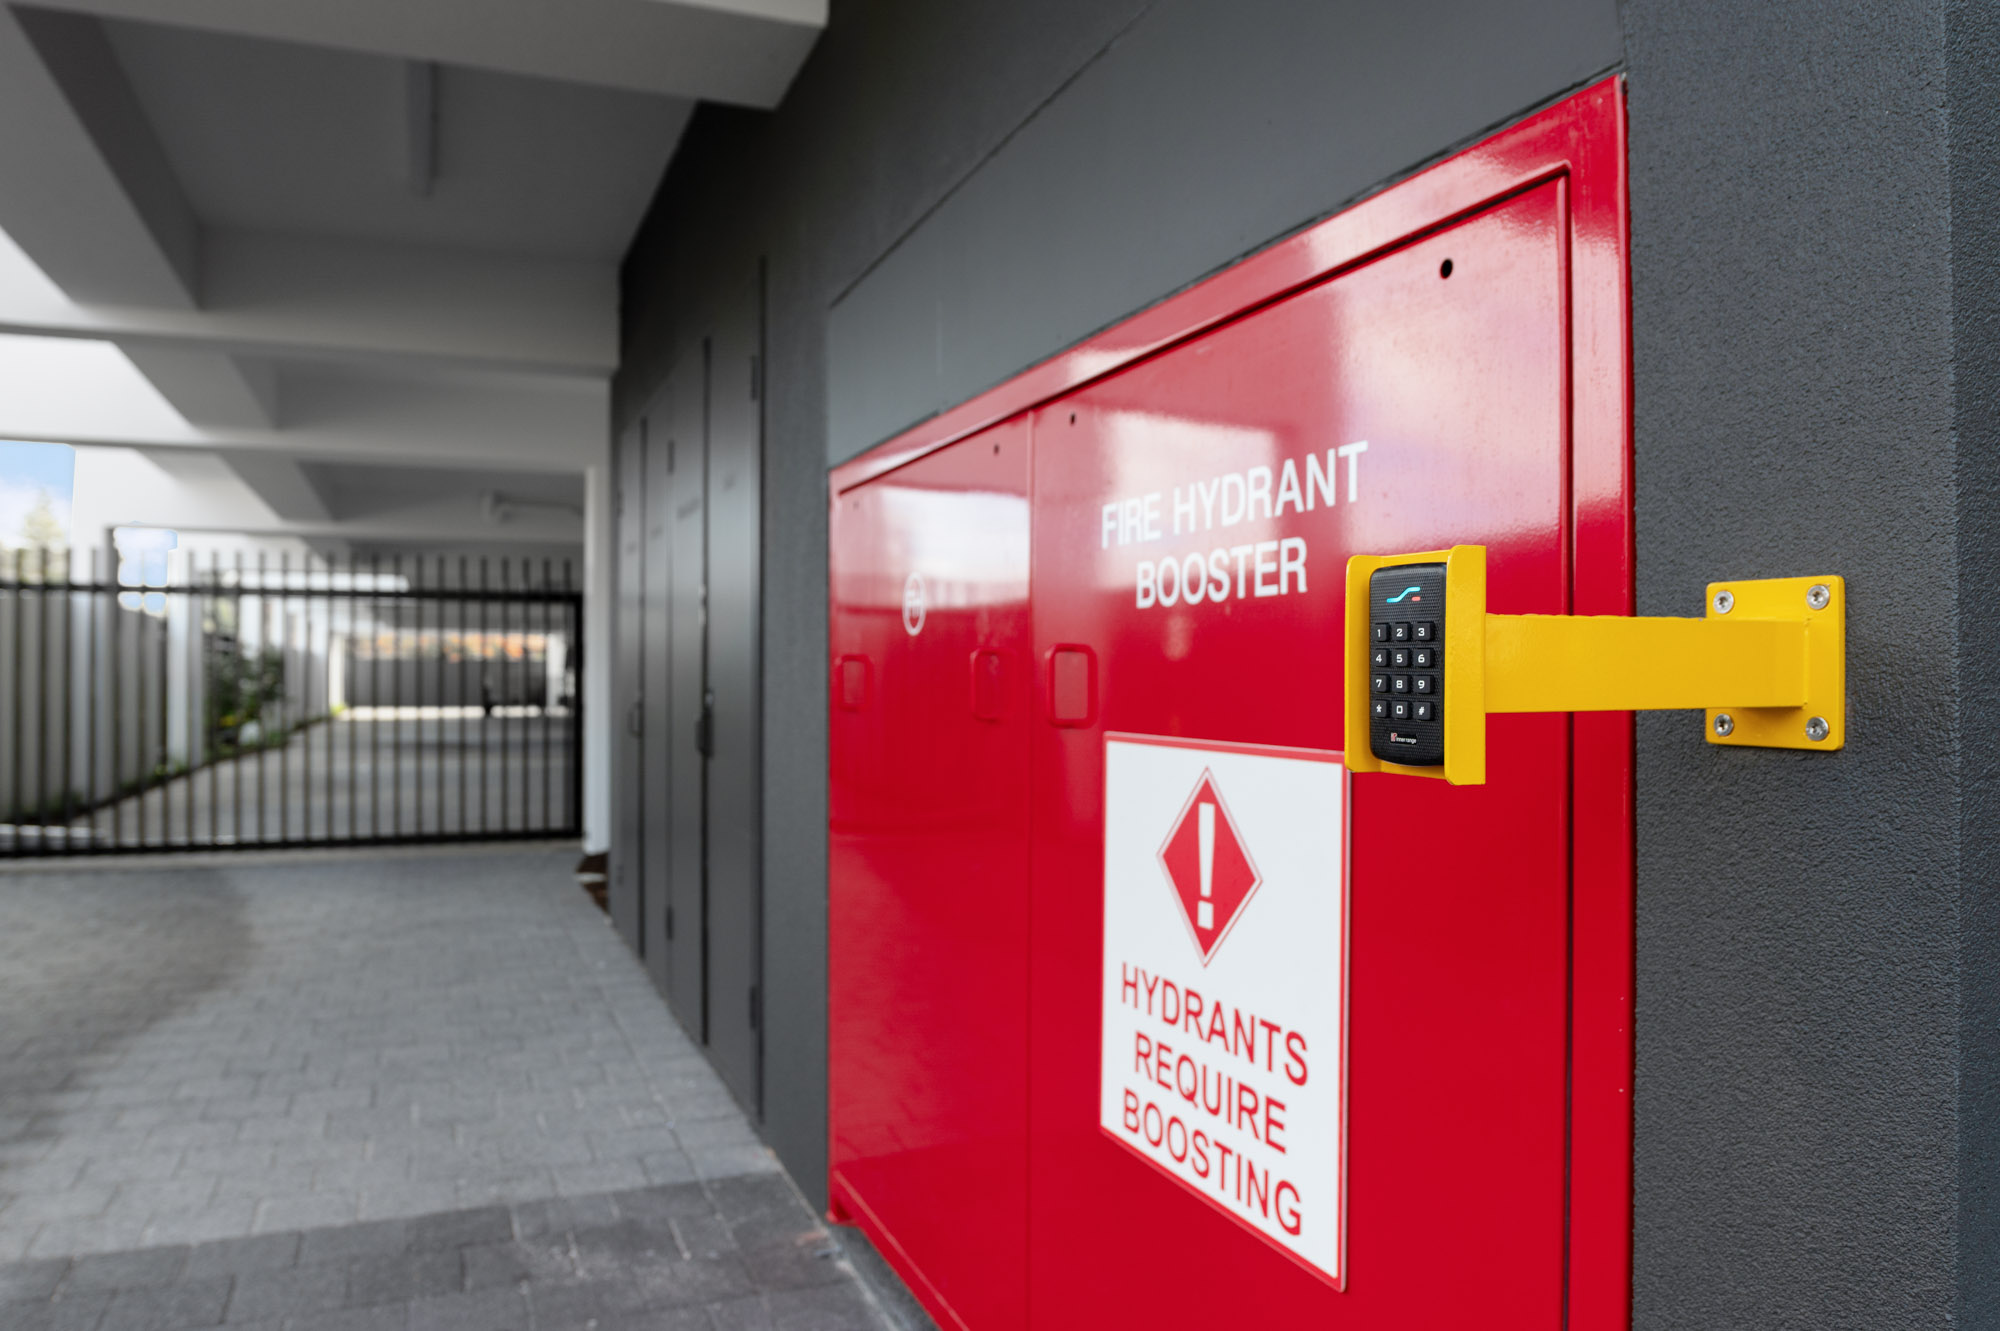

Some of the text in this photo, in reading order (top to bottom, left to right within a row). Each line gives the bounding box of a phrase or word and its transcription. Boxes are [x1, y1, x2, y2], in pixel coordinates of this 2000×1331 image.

[1101, 440, 1369, 549] FIRE HYDRANT
[1136, 536, 1308, 609] BOOSTER
[1375, 654, 1425, 663] 4 5 6
[1396, 628, 1403, 637] 2
[1418, 627, 1425, 637] 3
[1375, 679, 1425, 689] 7 8 9
[1396, 705, 1403, 714] 0
[1122, 961, 1308, 1086] HYDRANTS
[1135, 1030, 1287, 1155] REQUIRE
[1123, 1086, 1302, 1237] BOOSTING
